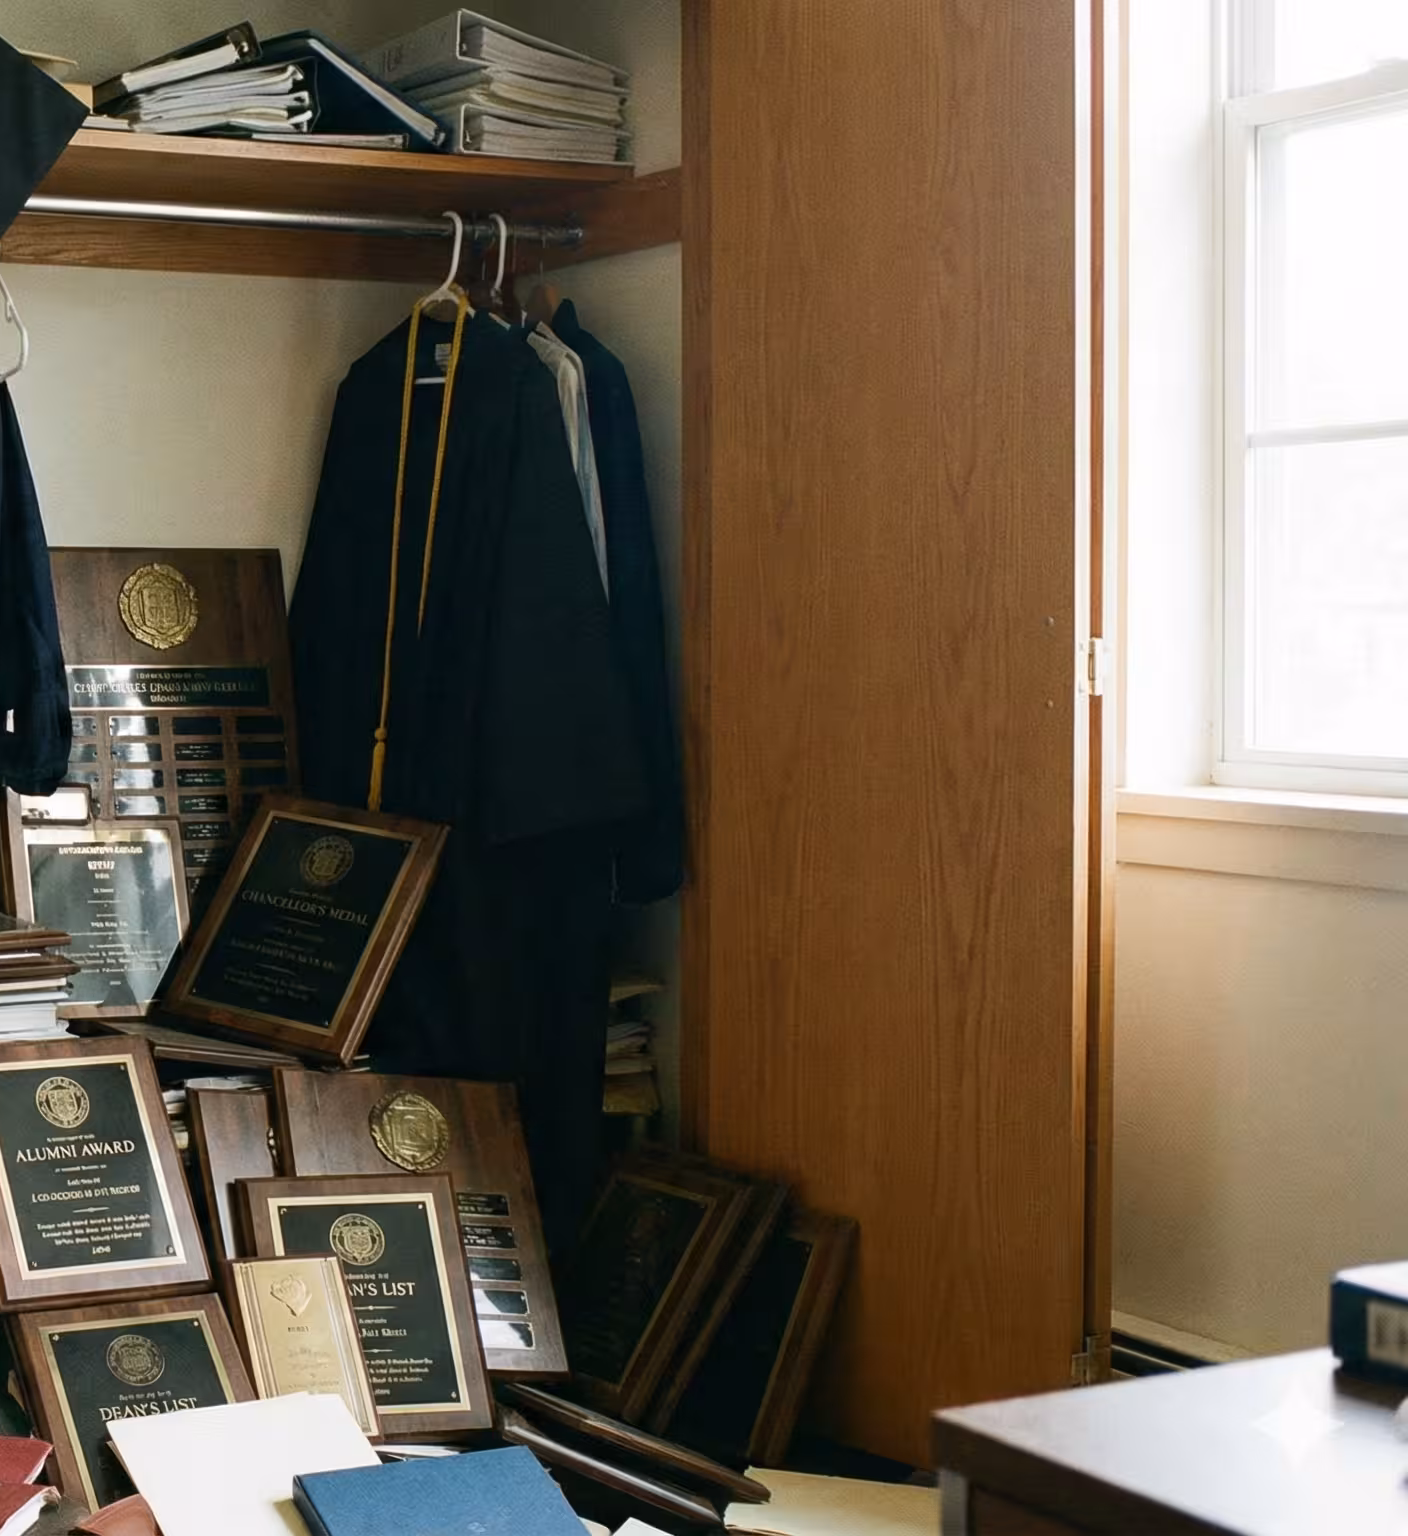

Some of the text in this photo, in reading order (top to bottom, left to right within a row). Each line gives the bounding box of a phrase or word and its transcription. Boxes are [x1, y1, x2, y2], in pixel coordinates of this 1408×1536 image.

[241, 889, 369, 926] CHANCELLOR'S MEDAL
[16, 1140, 135, 1163] ALUMNI AWARD
[382, 1282, 416, 1296] LIST
[99, 1397, 198, 1422] DEAN'S LIST
